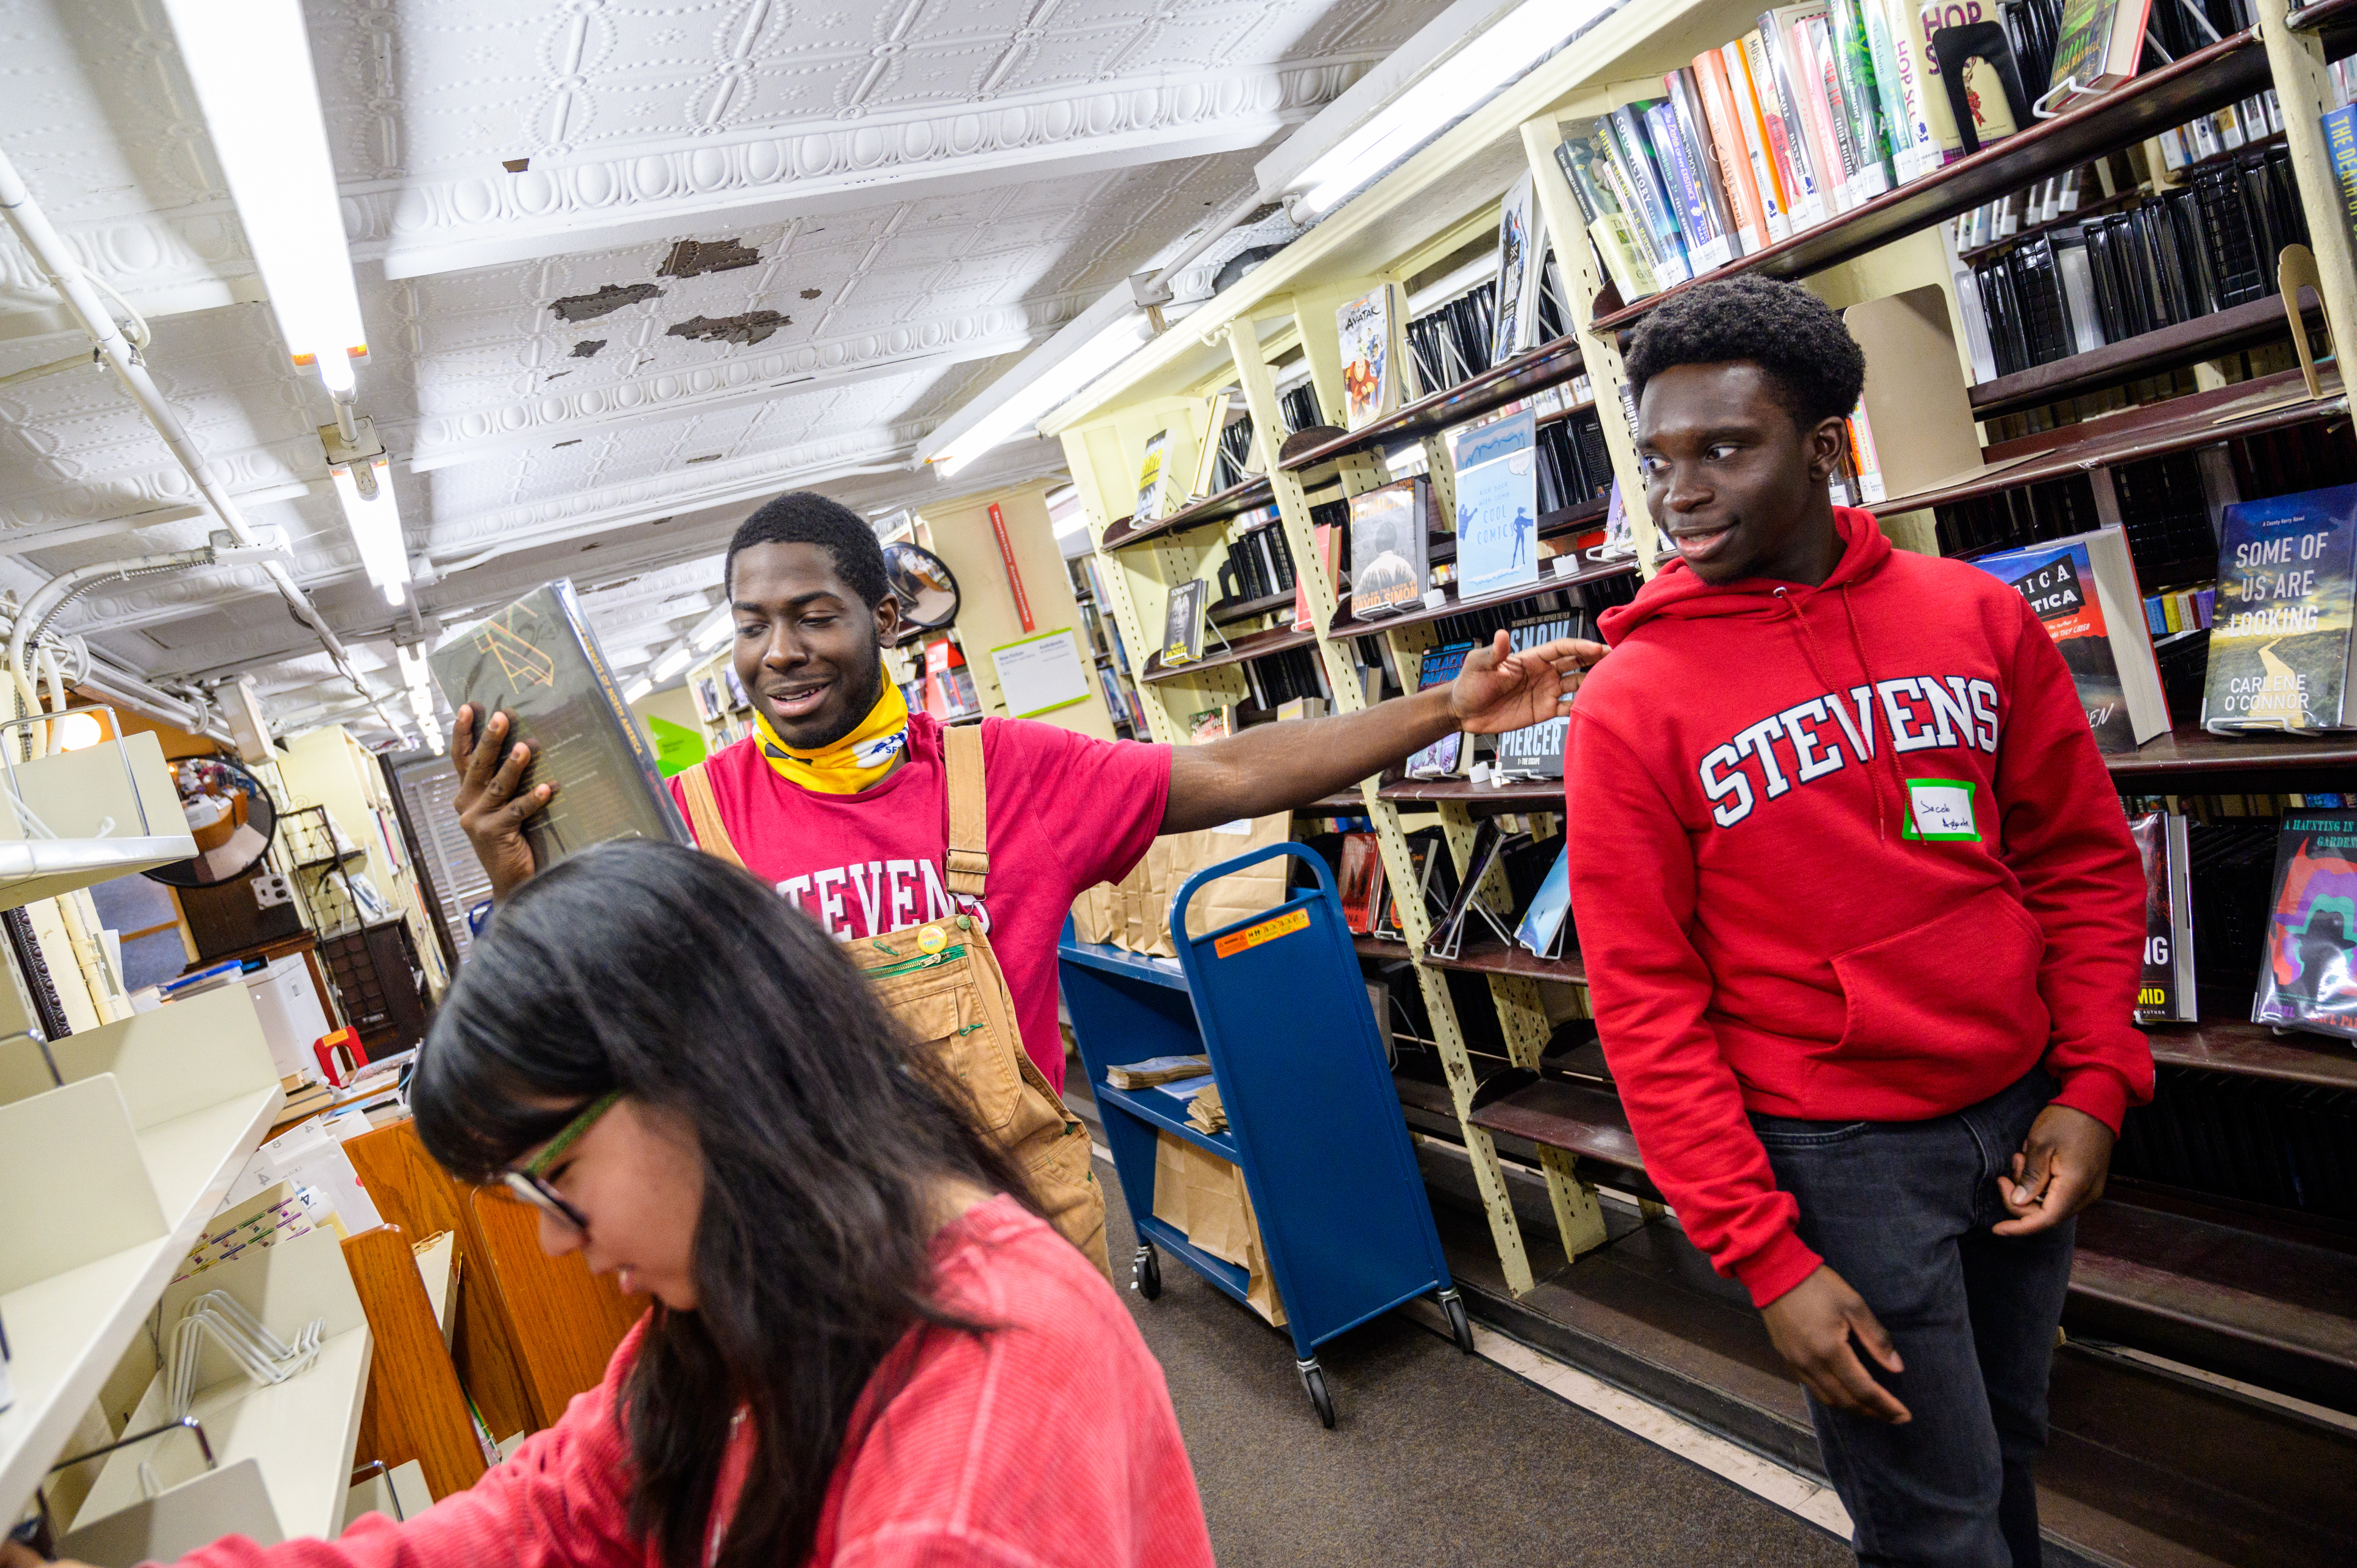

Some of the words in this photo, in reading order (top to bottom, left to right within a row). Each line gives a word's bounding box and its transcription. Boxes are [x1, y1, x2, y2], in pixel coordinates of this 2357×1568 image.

[1922, 1, 1982, 41] HOP
[1897, 40, 1914, 85] HOP
[1829, 88, 1842, 107] LIE
[1663, 112, 1671, 124] The
[1769, 115, 1783, 142] DAVID
[1812, 100, 1825, 136] PEOPLE
[1847, 79, 1861, 118] ABERNATHY
[1861, 146, 1870, 165] KIND
[1885, 112, 1895, 137] GIRL
[2329, 116, 2354, 148] THE
[1598, 129, 1615, 161] MISTER
[1667, 124, 1680, 148] Dane
[1834, 117, 1846, 143] FREIDA
[1841, 143, 1853, 176] McFADDE
[1615, 115, 1633, 148] COLD
[1628, 154, 1652, 203] VICTORY
[1659, 149, 1673, 181] UNBOUND
[1675, 147, 1681, 157] OF
[1677, 157, 1685, 168] MY
[1684, 143, 1697, 176] SPOON
[1680, 168, 1696, 201] EXISTENCE
[1722, 159, 1735, 189] AYANA
[2336, 147, 2357, 198] DEATH
[1648, 207, 1656, 224] KARL
[1674, 197, 1683, 216] FREYA
[1681, 217, 1691, 239] MARSK
[1696, 226, 1706, 245] MART
[1700, 220, 1710, 243] JESSIC
[1345, 306, 1382, 331] AVATAR
[1623, 395, 1639, 443] NIGHTBLO
[1512, 454, 1527, 462] wanna
[1850, 427, 1859, 451] DWYER
[1856, 453, 1864, 475] MURPH
[1858, 422, 1866, 444] JOSEPH
[1864, 445, 1873, 470] MURRAY
[1478, 497, 1492, 506] with
[1494, 491, 1510, 501] some
[1483, 504, 1506, 524] COOL
[1477, 521, 1514, 546] COMICS
[2235, 537, 2293, 569] SOME
[2300, 531, 2329, 560] OF
[1171, 583, 1196, 597] TOUCHED
[1392, 583, 1407, 592] BOOK
[2013, 563, 2071, 597] RICA
[2241, 575, 2267, 602] US
[2273, 569, 2315, 599] ARE
[1351, 595, 1382, 614] DAVID
[1384, 585, 1418, 604] SIMON
[2030, 589, 2079, 613] TICA
[2056, 620, 2072, 628] author
[2060, 627, 2073, 637] THEY
[2229, 605, 2319, 638] LOOKING
[1510, 620, 1570, 655] SNOW
[1428, 653, 1465, 672] BLACK
[2230, 674, 2307, 694] CARLENE
[601, 674, 611, 686] OF
[607, 688, 624, 717] NORTH
[621, 718, 643, 756] AMERICA
[2224, 692, 2309, 712] O'CONNOR
[1501, 722, 1562, 757] PIERCER
[1698, 675, 1999, 829] STEVENS
[1528, 757, 1540, 765] ESCAPE
[1920, 800, 1950, 814] Jacob
[2284, 820, 2290, 830] A
[2293, 819, 2340, 832] HAUNTING
[2343, 821, 2355, 832] IN
[776, 859, 992, 943] TEVENS
[922, 931, 940, 939] HOBOKE
[2144, 936, 2168, 965] NG
[2138, 988, 2165, 1005] MID
